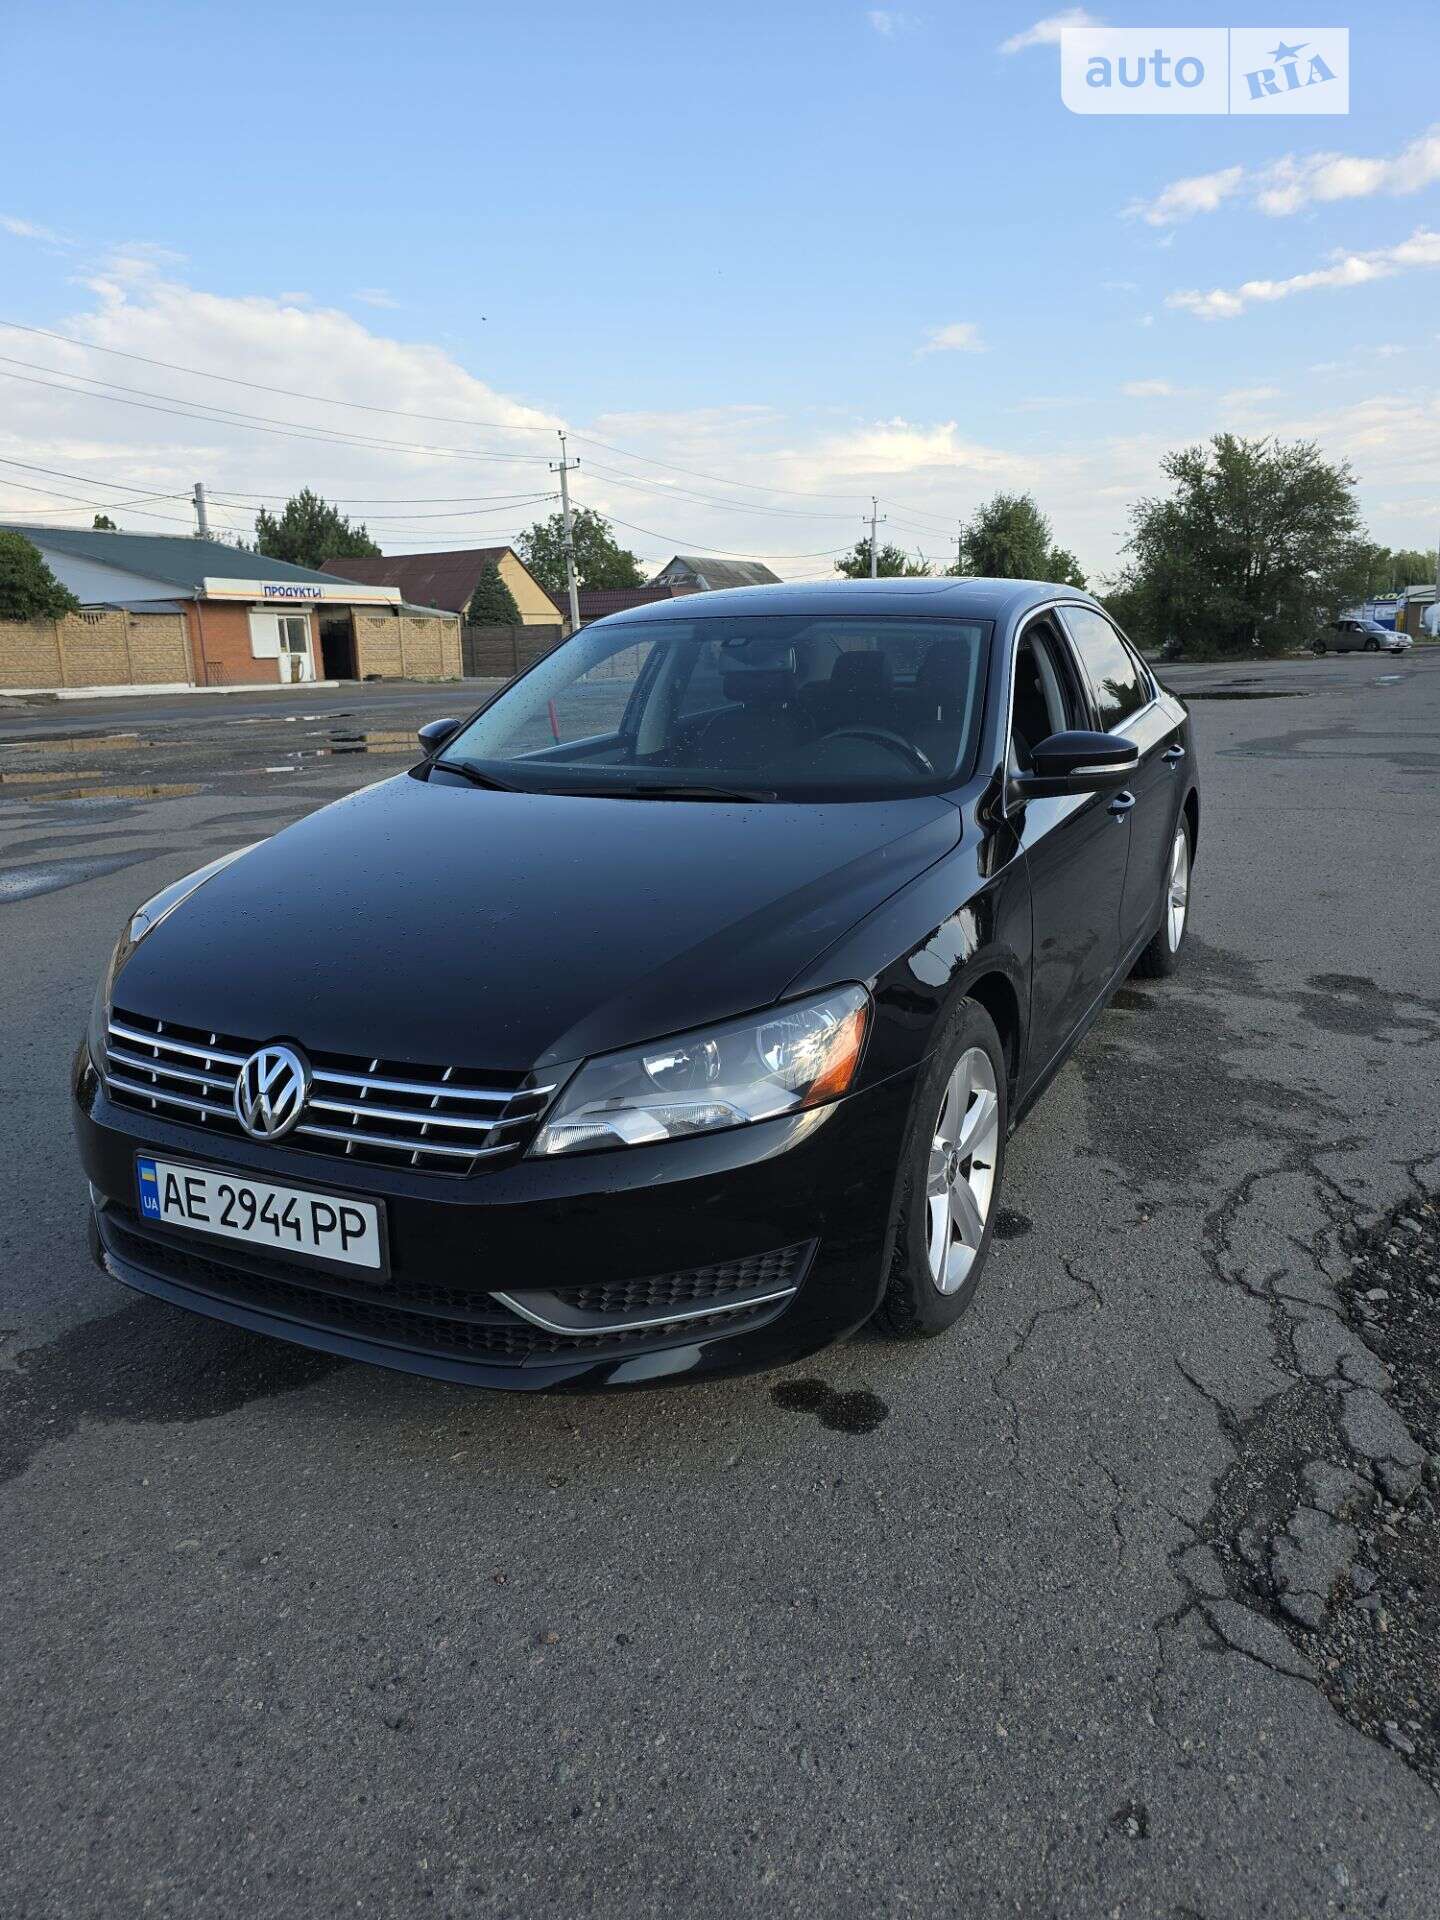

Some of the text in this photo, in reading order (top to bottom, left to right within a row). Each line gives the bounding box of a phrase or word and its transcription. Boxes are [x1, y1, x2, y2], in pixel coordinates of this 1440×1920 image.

[263, 585, 322, 598] ПРОДУКТЫ
[143, 1195, 158, 1211] UA
[164, 1172, 367, 1251] AE 2944 PP
